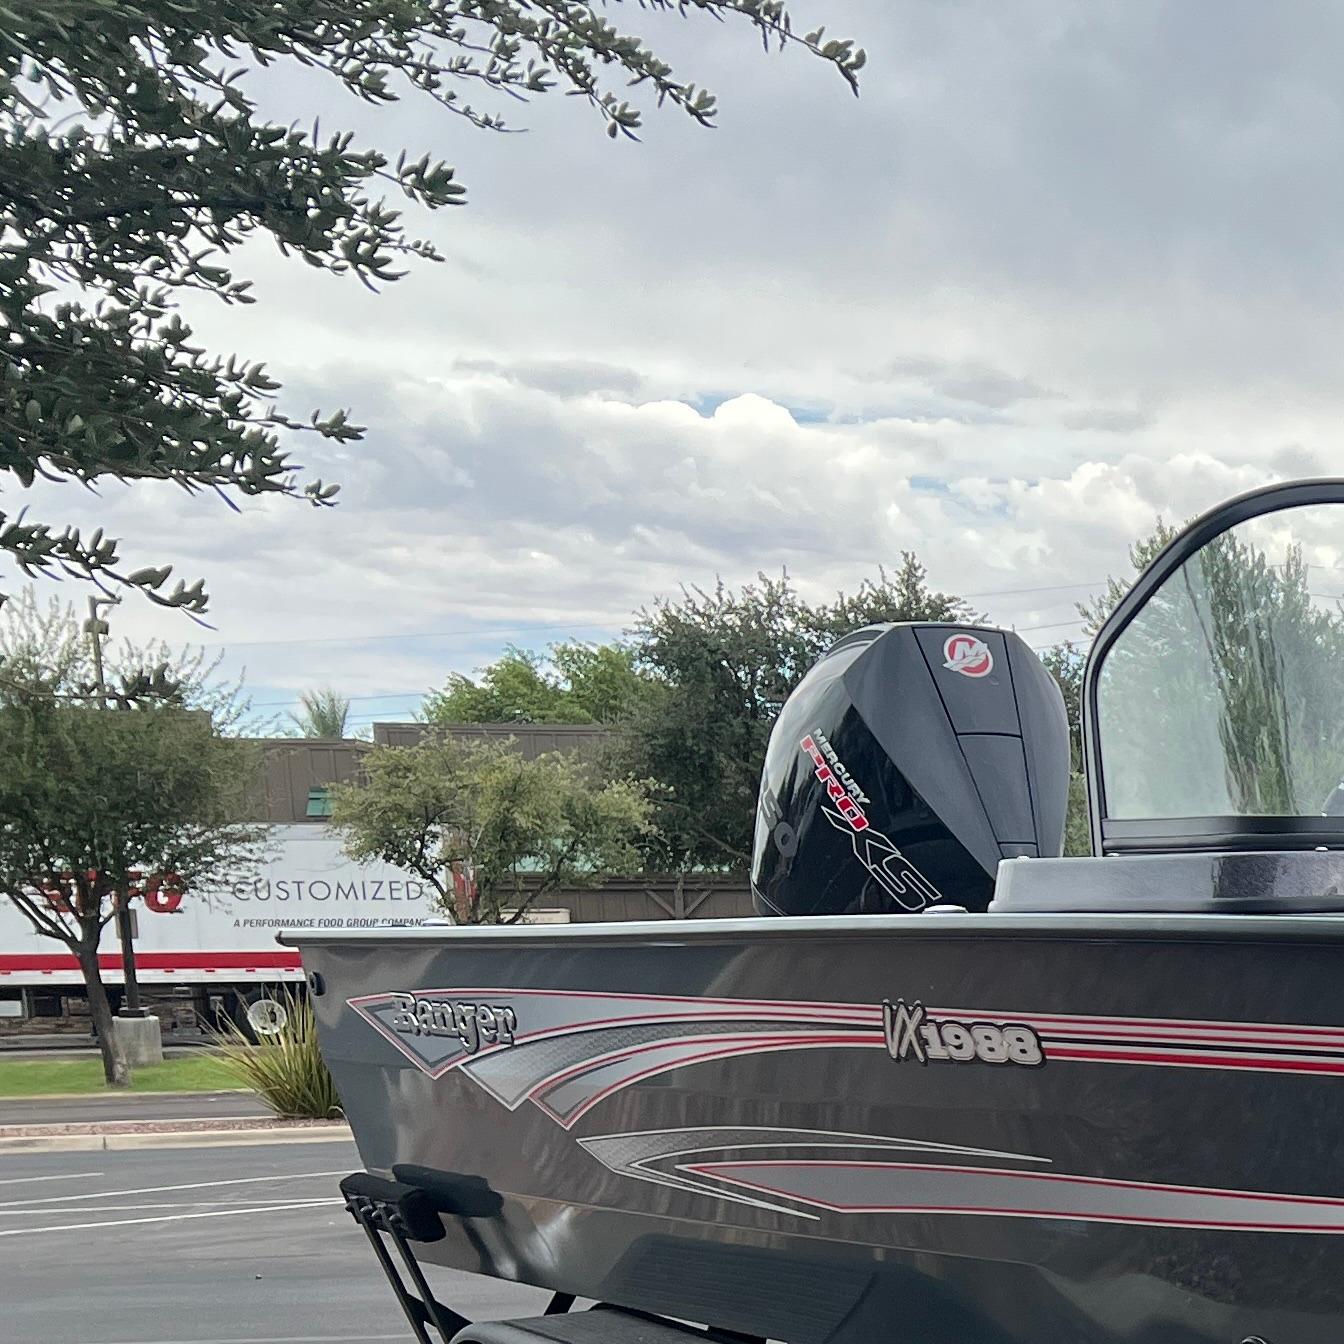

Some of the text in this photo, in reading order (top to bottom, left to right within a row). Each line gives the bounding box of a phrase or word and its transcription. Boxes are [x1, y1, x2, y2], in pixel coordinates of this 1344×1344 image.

[800, 734, 870, 832] PRO
[813, 727, 871, 804] MERCURY
[233, 880, 424, 901] CUSTOMIZED
[820, 805, 943, 911] XS
[233, 918, 241, 928] A
[243, 918, 315, 928] PERFORMANCE
[317, 918, 344, 928] FOOD
[346, 918, 378, 928] GROUP
[388, 988, 517, 1055] Ranger
